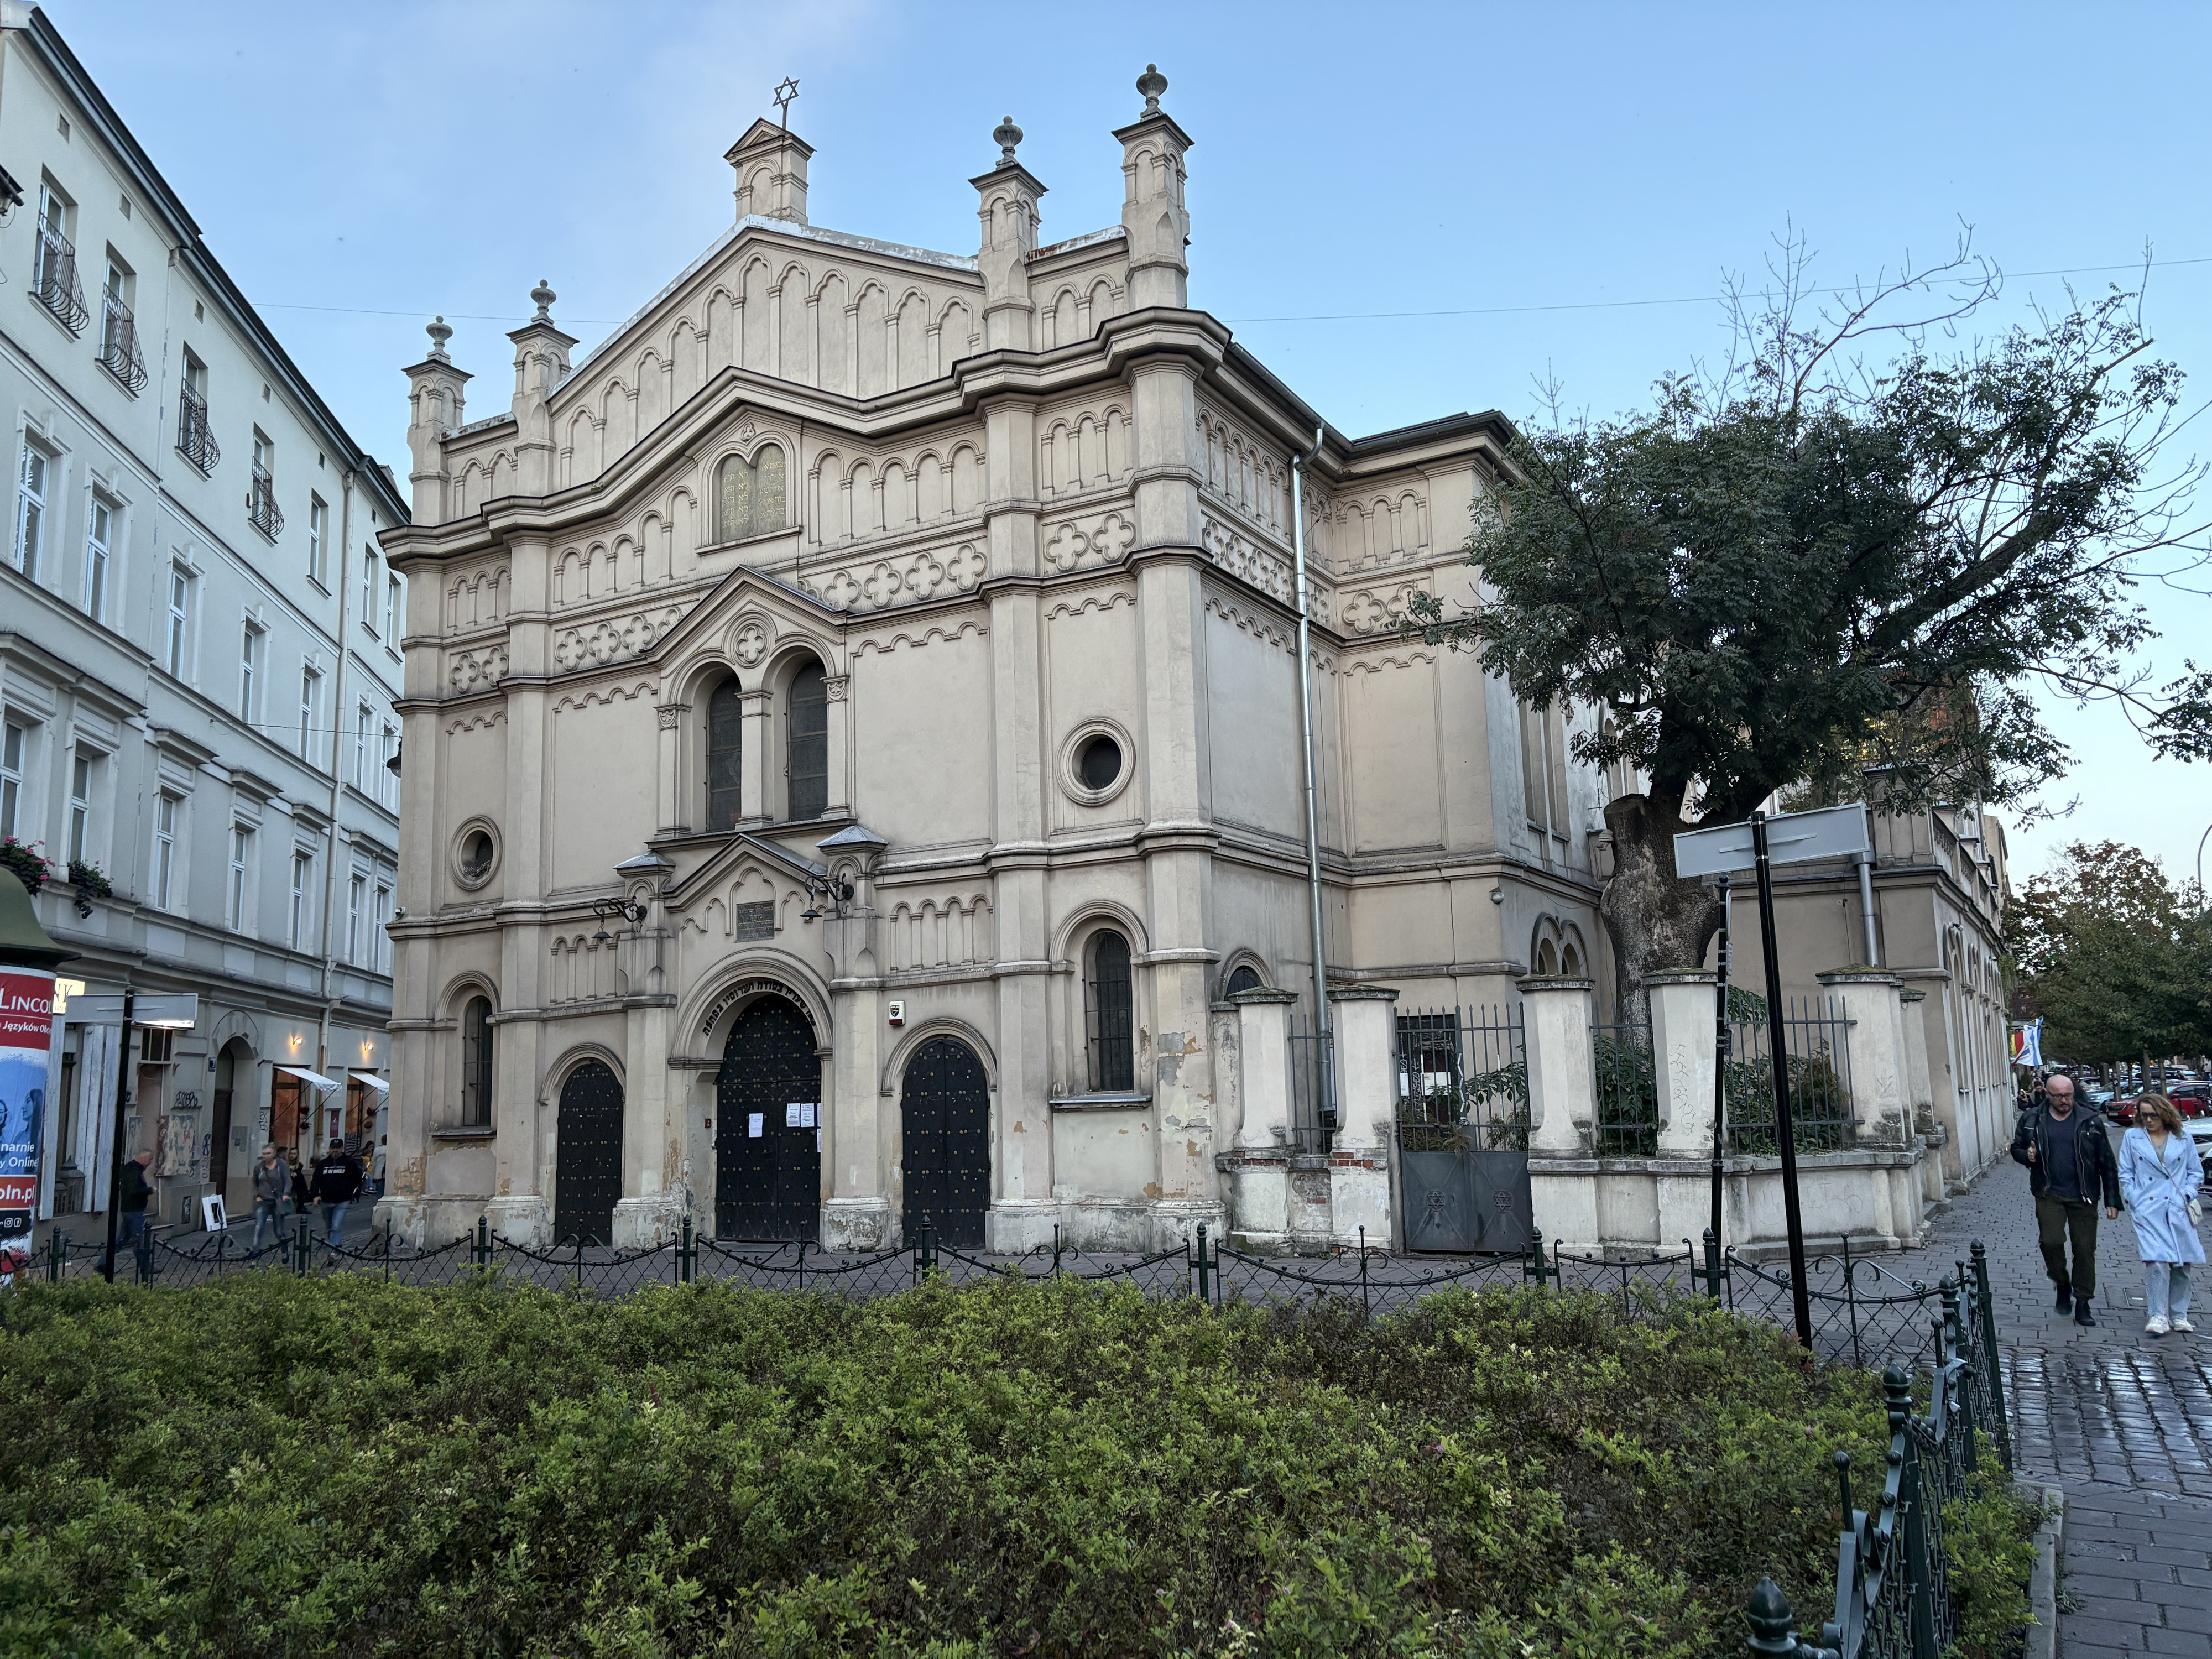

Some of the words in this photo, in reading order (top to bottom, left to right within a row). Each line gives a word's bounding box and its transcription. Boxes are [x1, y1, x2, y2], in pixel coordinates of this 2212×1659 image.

[0, 988, 51, 1014] LINCOL
[2, 1020, 39, 1033] Języków
[1, 1141, 35, 1152] narnie
[8, 1156, 39, 1167] Online
